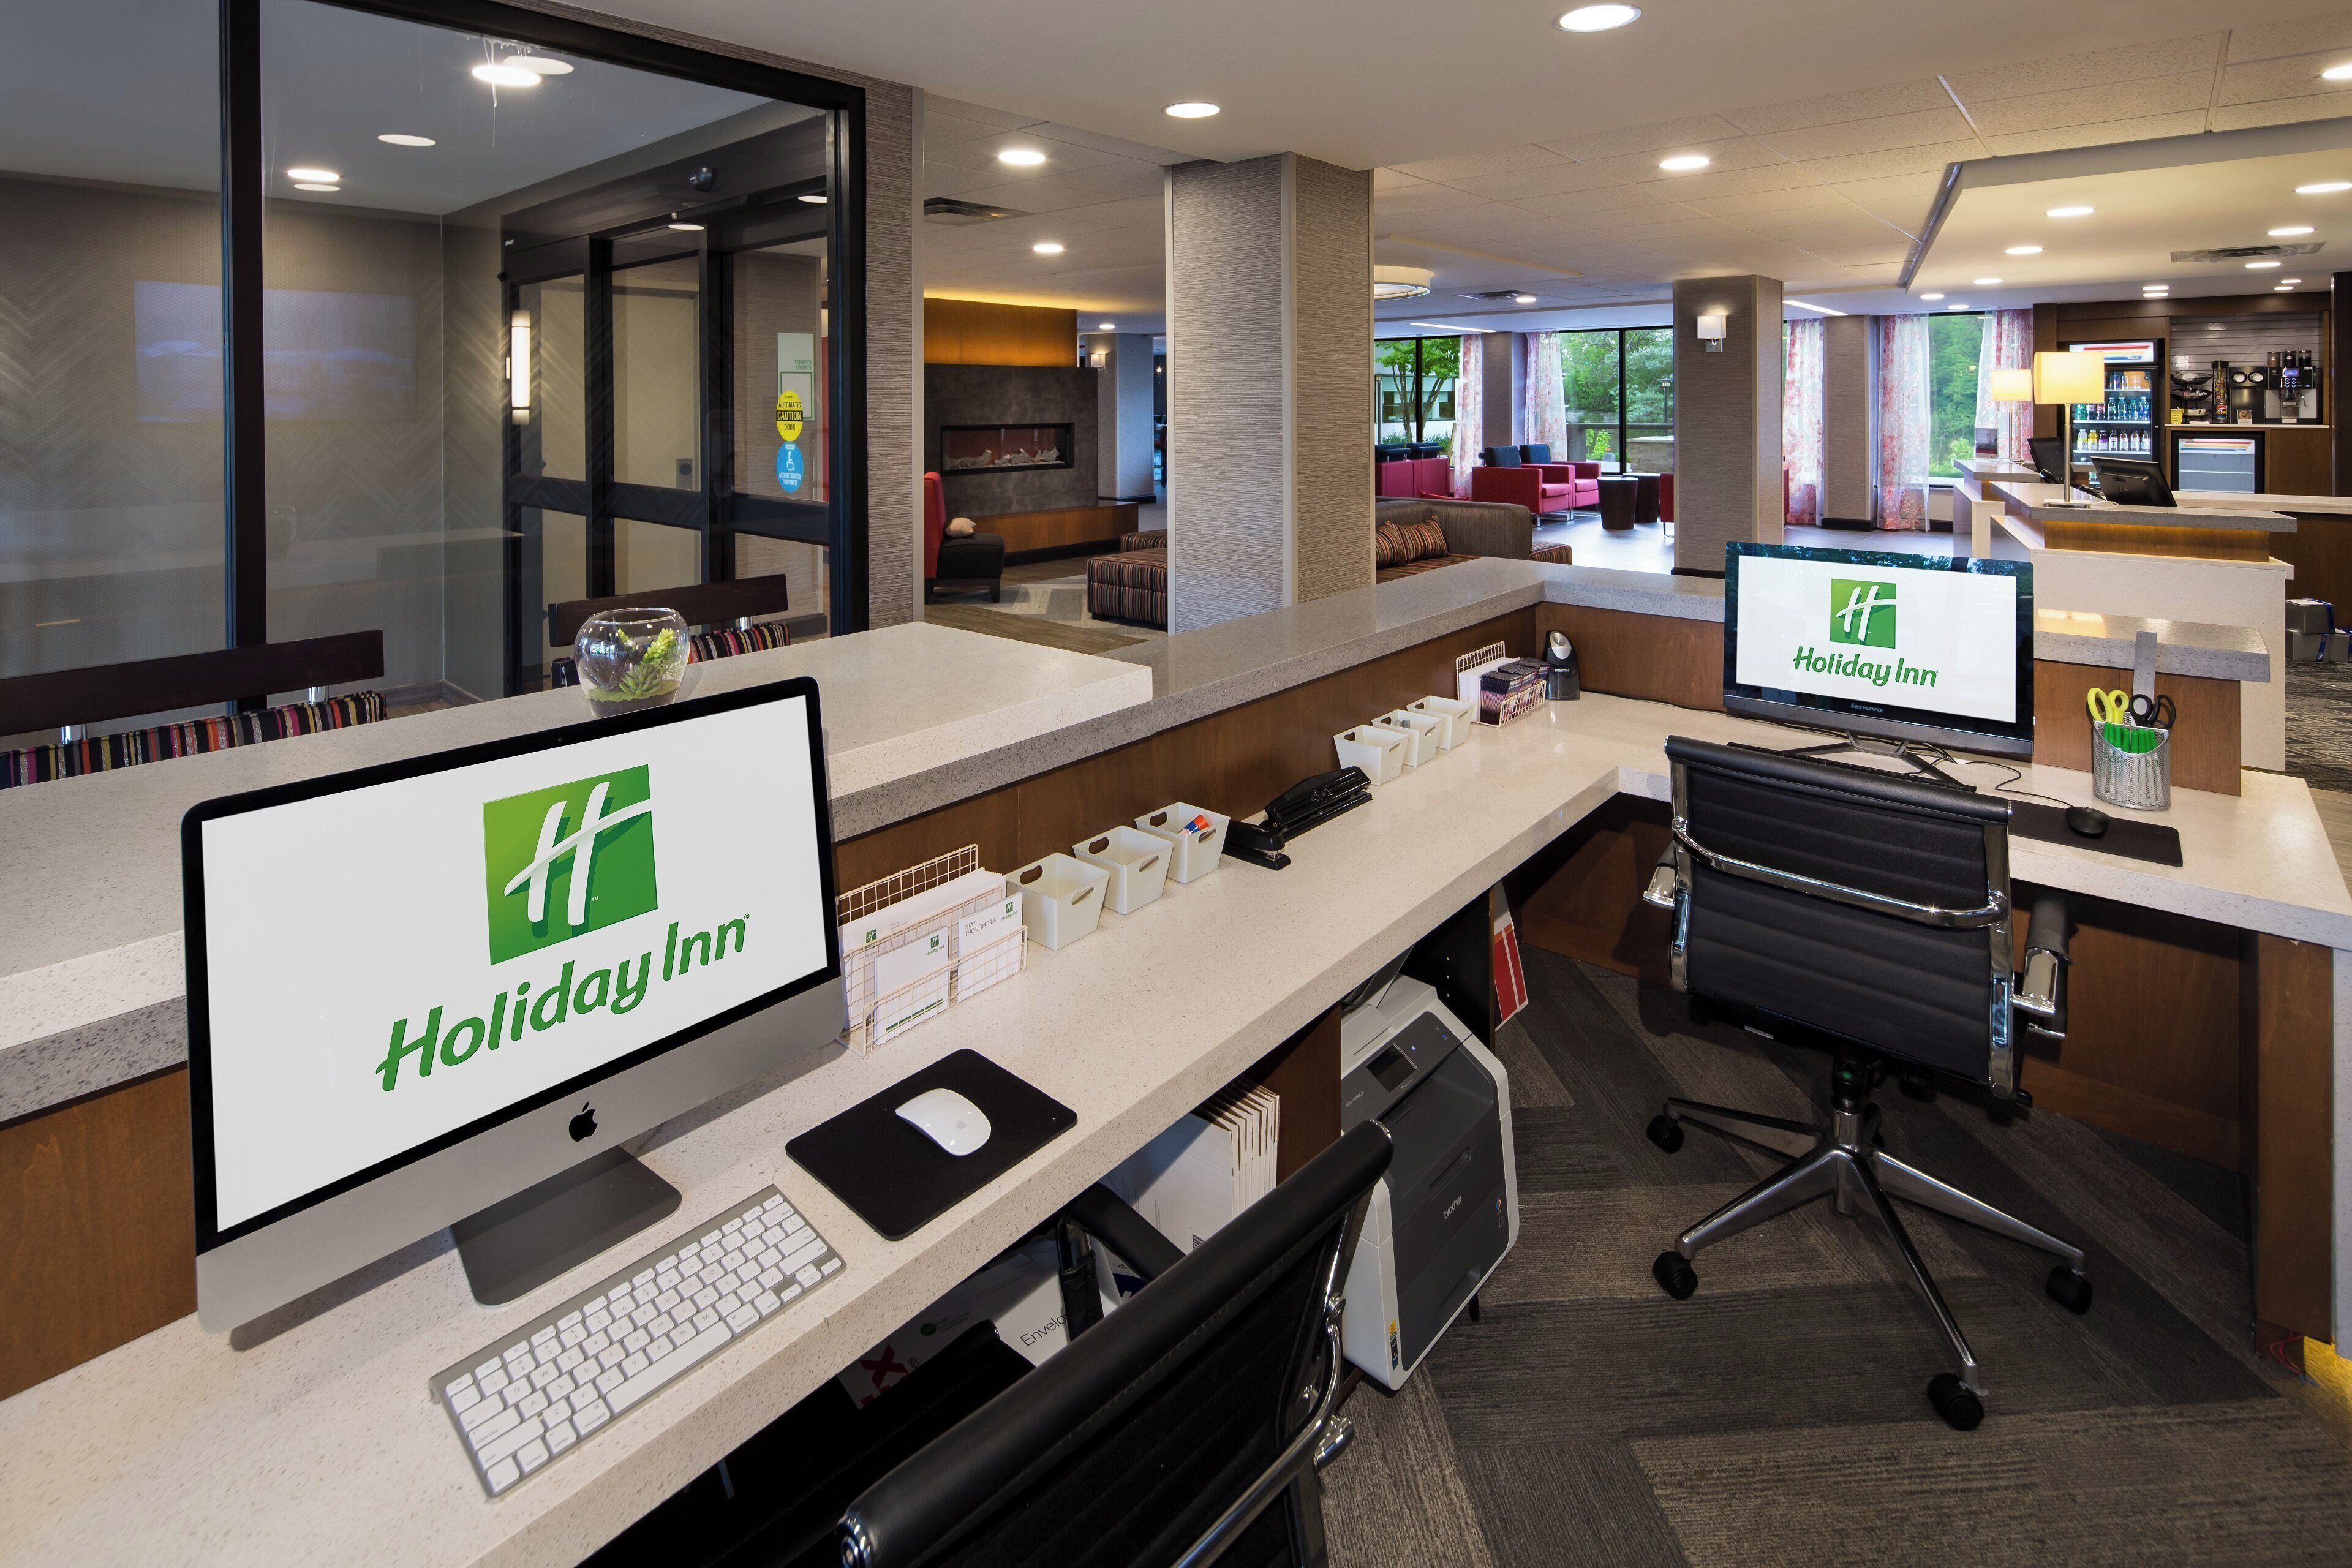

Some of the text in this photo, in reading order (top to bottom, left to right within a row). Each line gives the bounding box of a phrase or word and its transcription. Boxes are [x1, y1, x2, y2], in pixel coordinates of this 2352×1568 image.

[777, 411, 802, 421] CAUTION
[1793, 646, 1937, 687] Holiday Inn
[1850, 703, 1883, 712] lenovo
[965, 920, 976, 930] STAY
[925, 946, 939, 956] Holiday
[375, 914, 745, 1091] Holiday Inn
[1444, 1194, 1462, 1219] brother
[1020, 1313, 1068, 1347] Envelo
